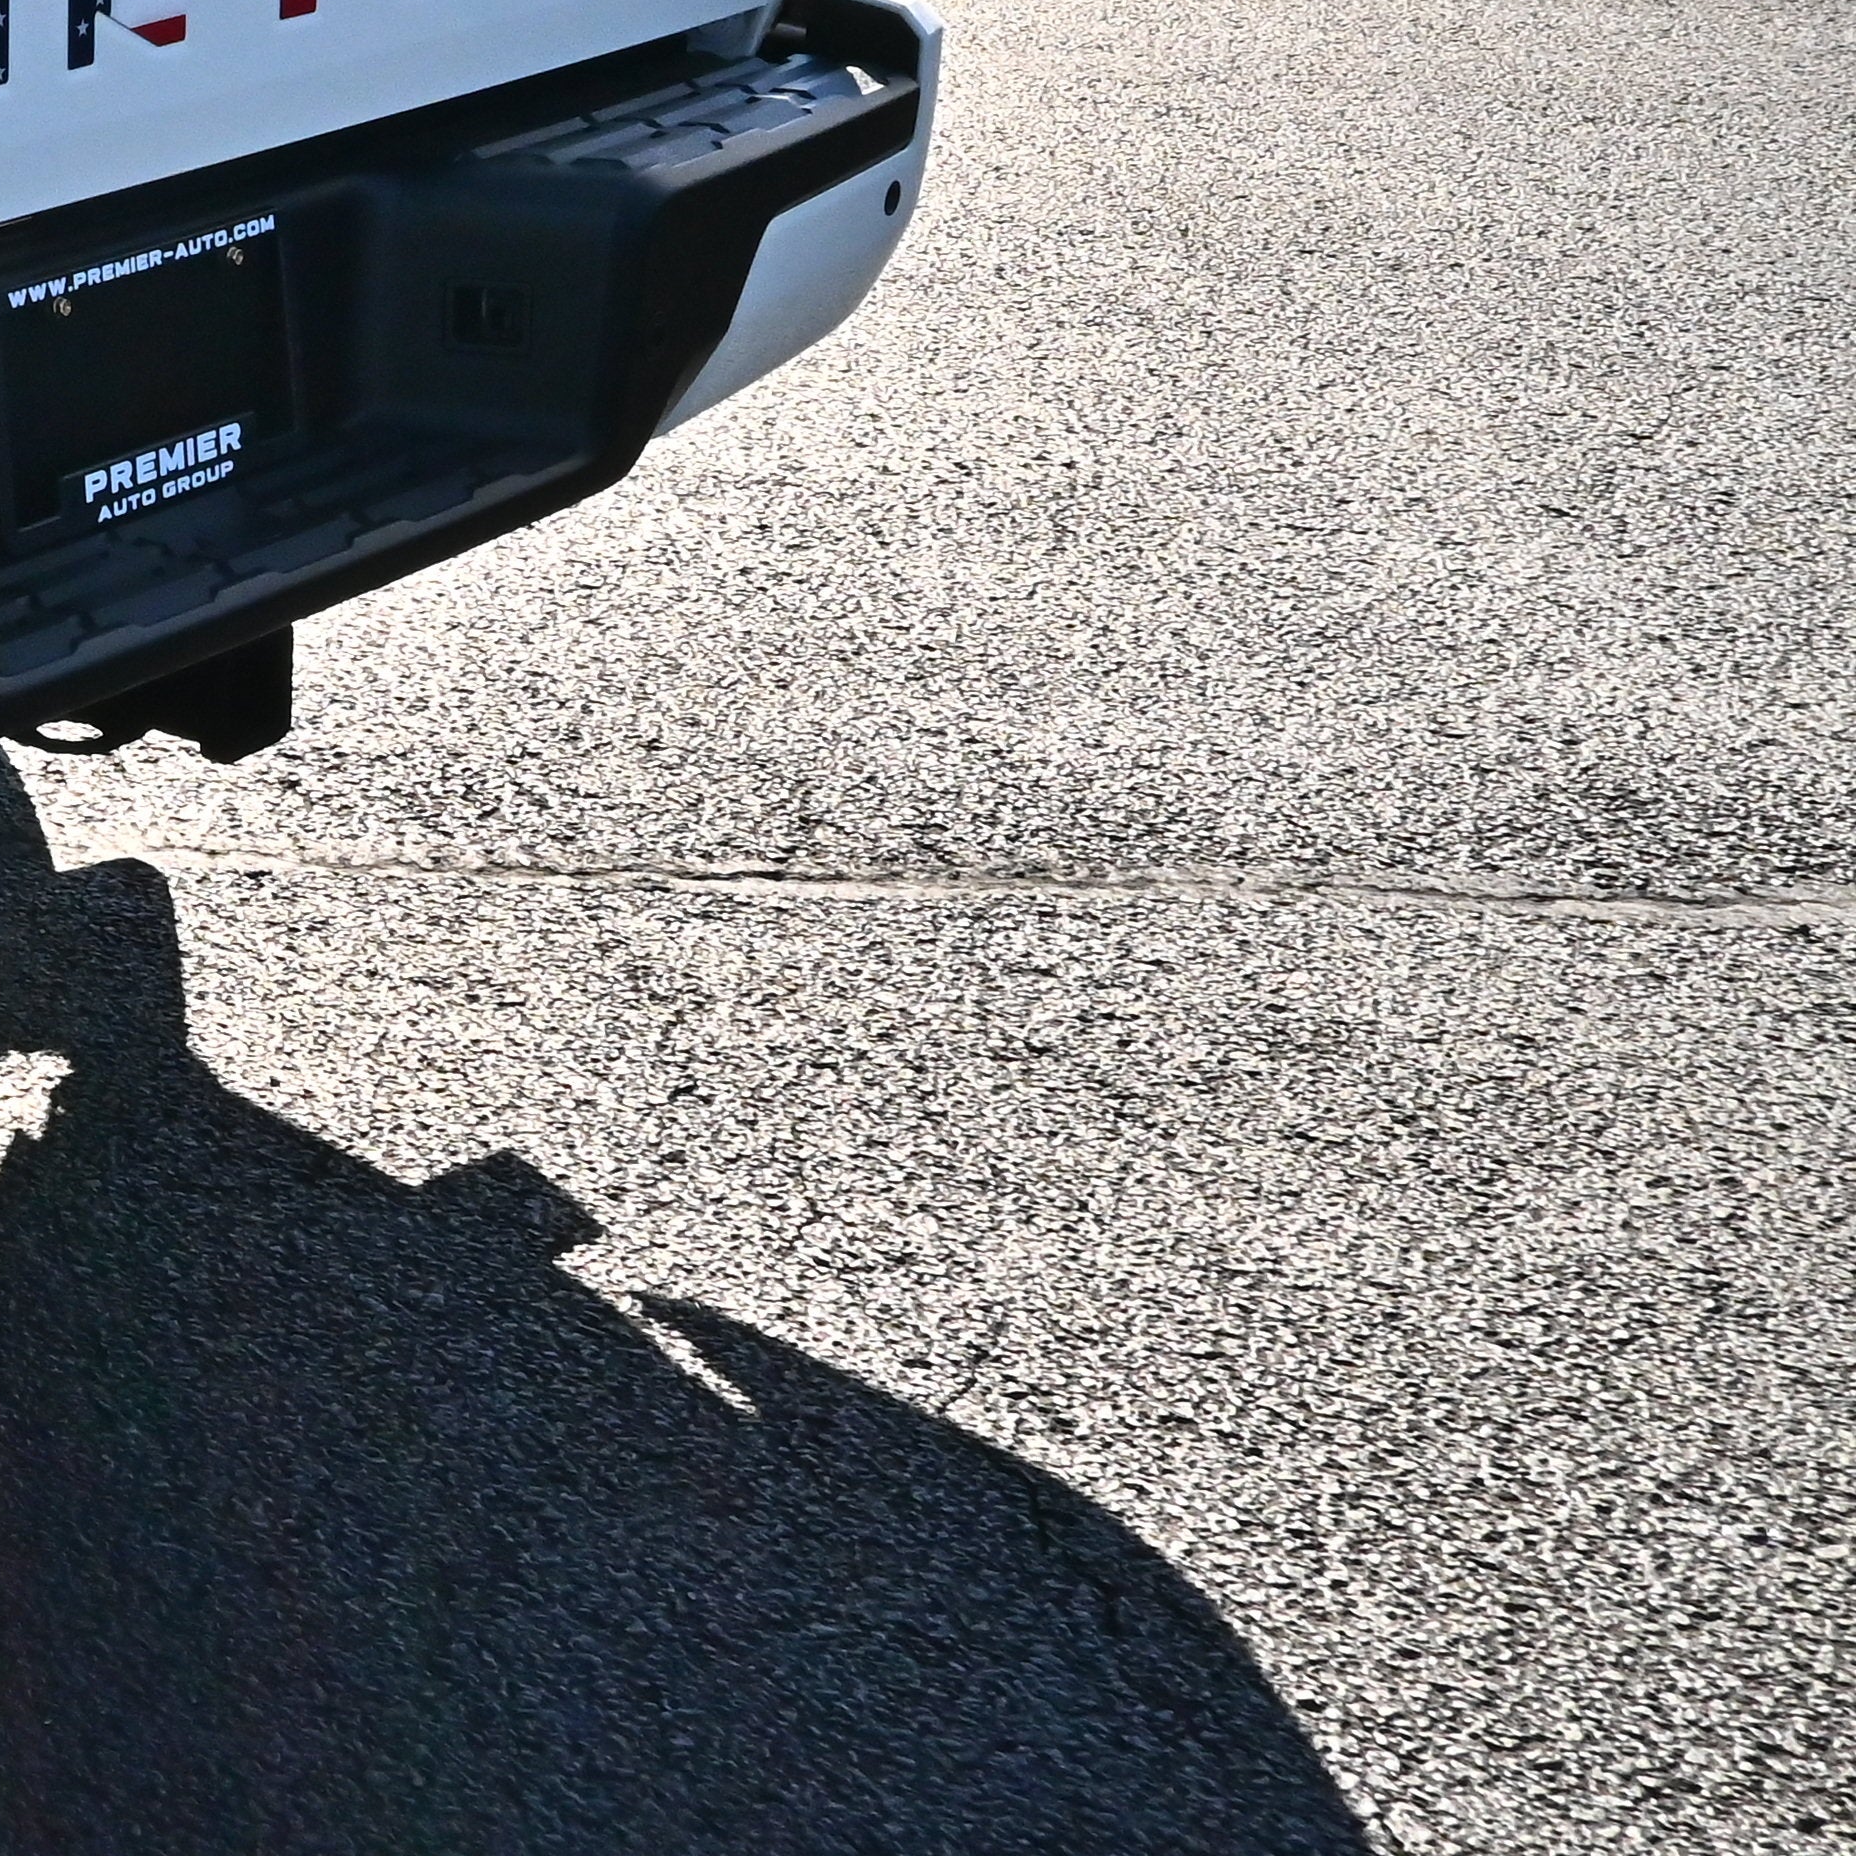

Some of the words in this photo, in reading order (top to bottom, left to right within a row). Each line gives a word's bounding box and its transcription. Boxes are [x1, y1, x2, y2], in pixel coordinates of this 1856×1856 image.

[8, 214, 275, 309] WWW.PREMIER-AUTO.COM
[84, 422, 242, 504] PREMIER
[97, 488, 156, 523] AUTO
[162, 460, 234, 499] GROUP
